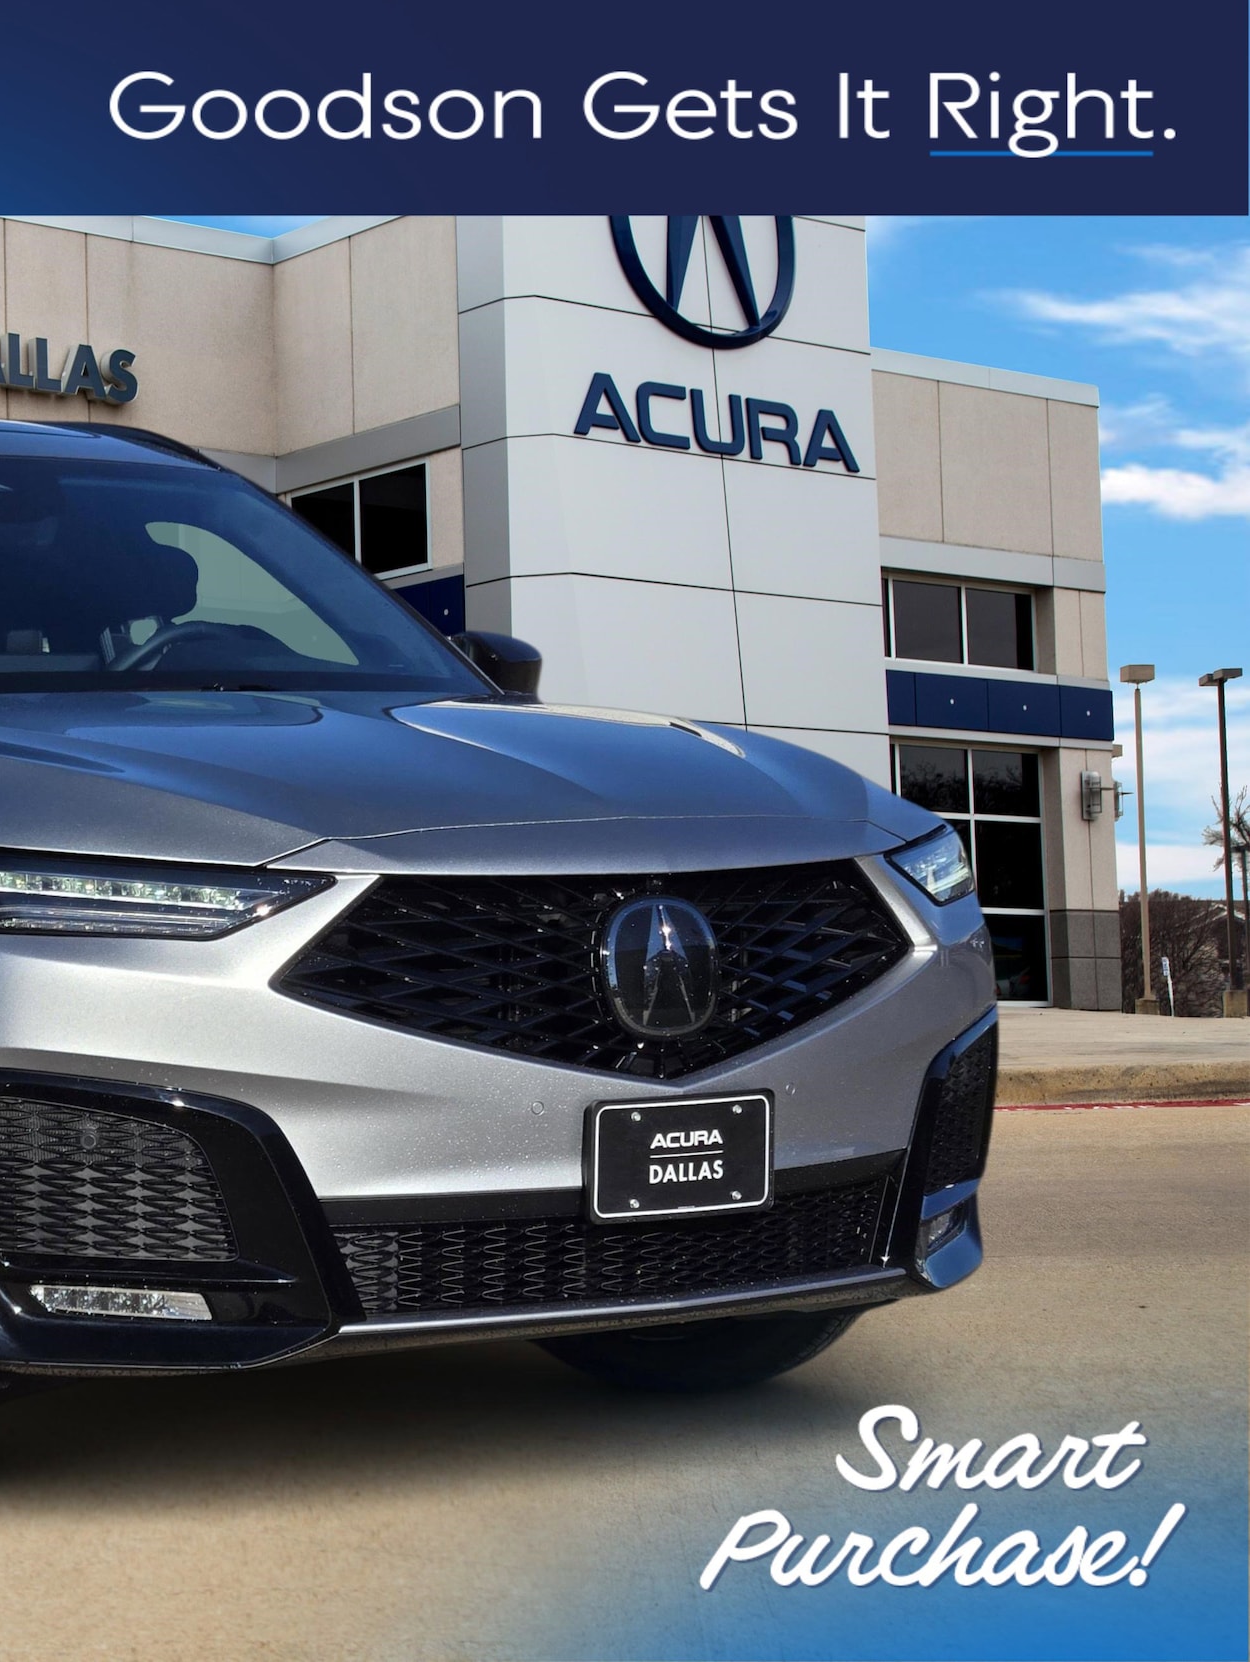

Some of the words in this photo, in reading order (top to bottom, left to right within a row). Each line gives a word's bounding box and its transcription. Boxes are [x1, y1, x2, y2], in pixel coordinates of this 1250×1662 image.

[573, 372, 860, 473] ACURA
[650, 1129, 724, 1150] ACURA
[649, 1159, 724, 1185] DALLAS
